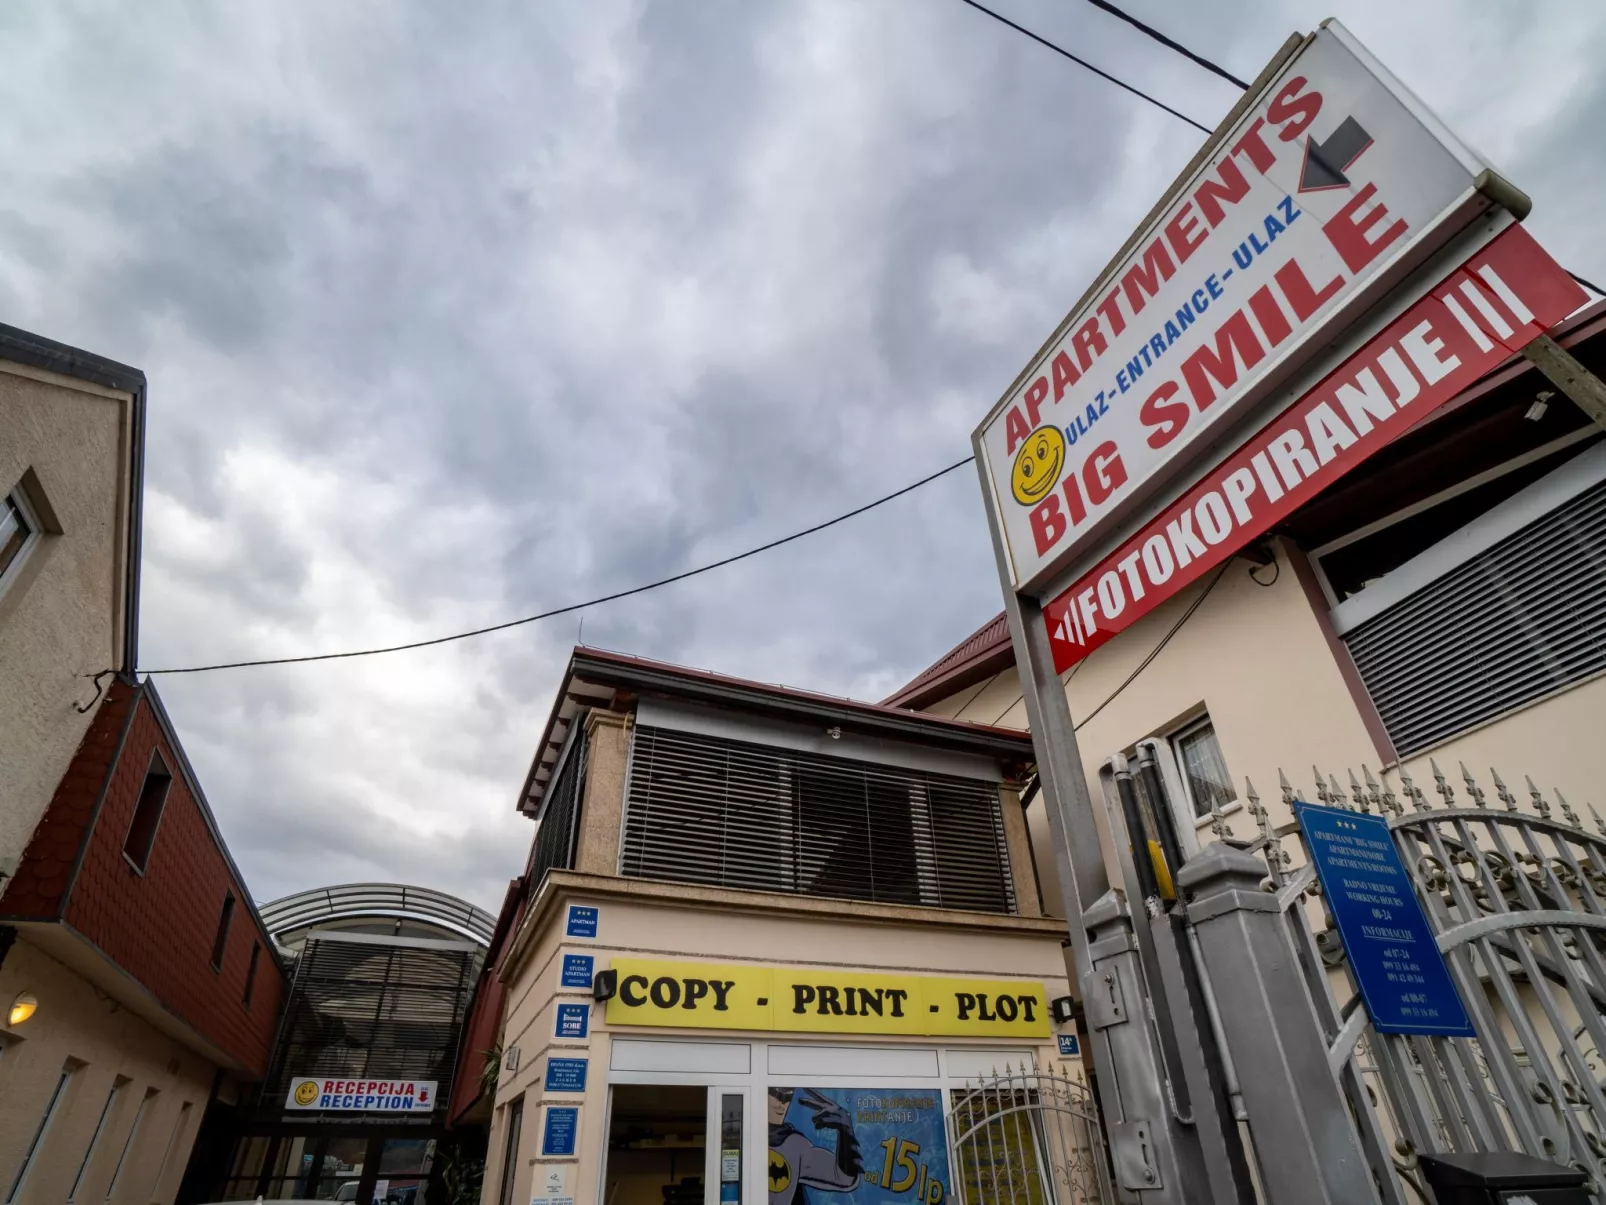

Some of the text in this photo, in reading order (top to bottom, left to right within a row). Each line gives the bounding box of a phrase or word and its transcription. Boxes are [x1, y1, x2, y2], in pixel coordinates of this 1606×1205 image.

[1006, 76, 1323, 456] APARTMENTS
[1028, 182, 1410, 558] BIG SMILE
[1078, 318, 1463, 638] FOTOKOPIRANJE
[1345, 891, 1380, 904] WORKING
[1361, 925, 1414, 940] INFORMACIJE
[618, 974, 736, 1013] COPY
[791, 984, 909, 1018] PRINT
[956, 992, 1038, 1023] PLOT
[320, 1095, 413, 1109] RECEPTION
[323, 1081, 415, 1096] RECEPCIJA
[863, 1170, 879, 1184] od
[880, 1136, 920, 1193] 15
